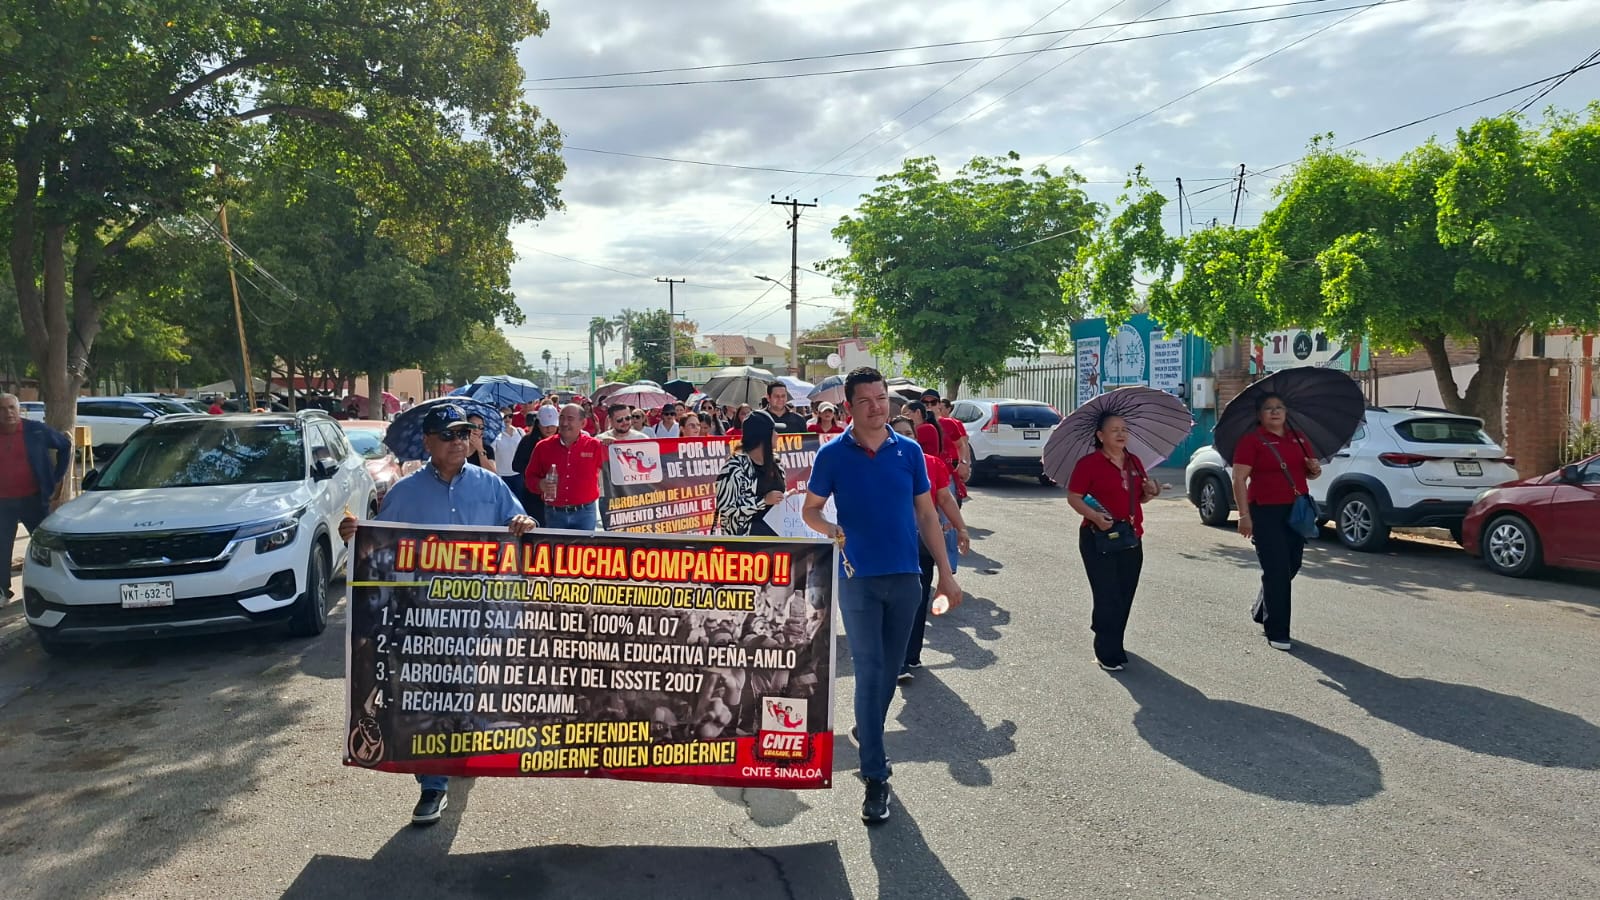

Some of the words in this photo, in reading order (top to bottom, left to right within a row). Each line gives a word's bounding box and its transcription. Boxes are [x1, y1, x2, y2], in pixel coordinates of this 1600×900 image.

[677, 441, 704, 460] POR
[707, 440, 726, 457] UN
[772, 435, 803, 452] AYO
[623, 473, 651, 482] CNTE
[666, 461, 685, 479] DE
[780, 450, 817, 469] ATIVO
[608, 488, 666, 511] ABROGACIÓN
[667, 488, 679, 500] DE
[680, 487, 694, 499] LA
[694, 483, 711, 497] LEY
[609, 508, 654, 526] AUMENTO
[655, 501, 700, 519] SALARIAL
[701, 498, 713, 511] DE
[655, 516, 700, 533] SERVICIOS
[420, 534, 498, 572] ÚNETE
[501, 543, 518, 572] A
[524, 545, 550, 574] LA
[555, 546, 627, 577] LUCHA
[631, 547, 770, 583] COMPAÑERO
[774, 554, 789, 584] !!
[122, 587, 172, 601] VKT-632-C
[429, 578, 482, 600] APOYO
[485, 579, 529, 601] TOTAL
[532, 582, 551, 602] AL
[553, 584, 590, 604] PARO
[592, 585, 671, 607] INDEFINIDO
[673, 588, 692, 608] DE
[695, 589, 714, 609] LA
[716, 590, 755, 611] CNTE
[381, 606, 400, 626] 1.-
[404, 607, 481, 629] AUMENTO
[484, 609, 557, 631] SALARIAL
[560, 612, 586, 633] DEL
[592, 613, 633, 636] 100%
[637, 615, 655, 636] AL
[659, 617, 679, 637] 07
[376, 633, 398, 654] 2.-
[401, 633, 501, 657] ABROGACIÓN
[505, 637, 527, 657] DE
[530, 638, 549, 658] LA
[552, 638, 620, 662] REFORMA
[623, 642, 704, 666] EDUCATIVA
[708, 644, 796, 669] PEÑA-AMLO
[375, 661, 396, 681] 3.-
[399, 661, 500, 685] ABROGACIÓN
[503, 664, 523, 685] DE
[527, 665, 547, 686] LA
[551, 666, 578, 687] LEY
[580, 667, 608, 689] DEL
[610, 669, 662, 691] ISSSTE
[664, 671, 704, 694] 2007
[374, 689, 394, 709] 4.-
[401, 690, 475, 712] RECHAZO
[477, 692, 498, 713] AL
[501, 693, 579, 714] USICAMM.
[411, 733, 447, 755] ¡LOS
[450, 726, 538, 753] DERECHOS
[540, 724, 562, 746] SE
[564, 721, 654, 745] DEFIENDEN,
[762, 733, 805, 750] CNTE
[520, 747, 600, 772] GOBIERNE
[602, 745, 649, 768] QUIEN
[652, 739, 736, 765] GOBIÉRNE!
[741, 766, 772, 777] CNTE
[774, 767, 823, 778] SINALOA
